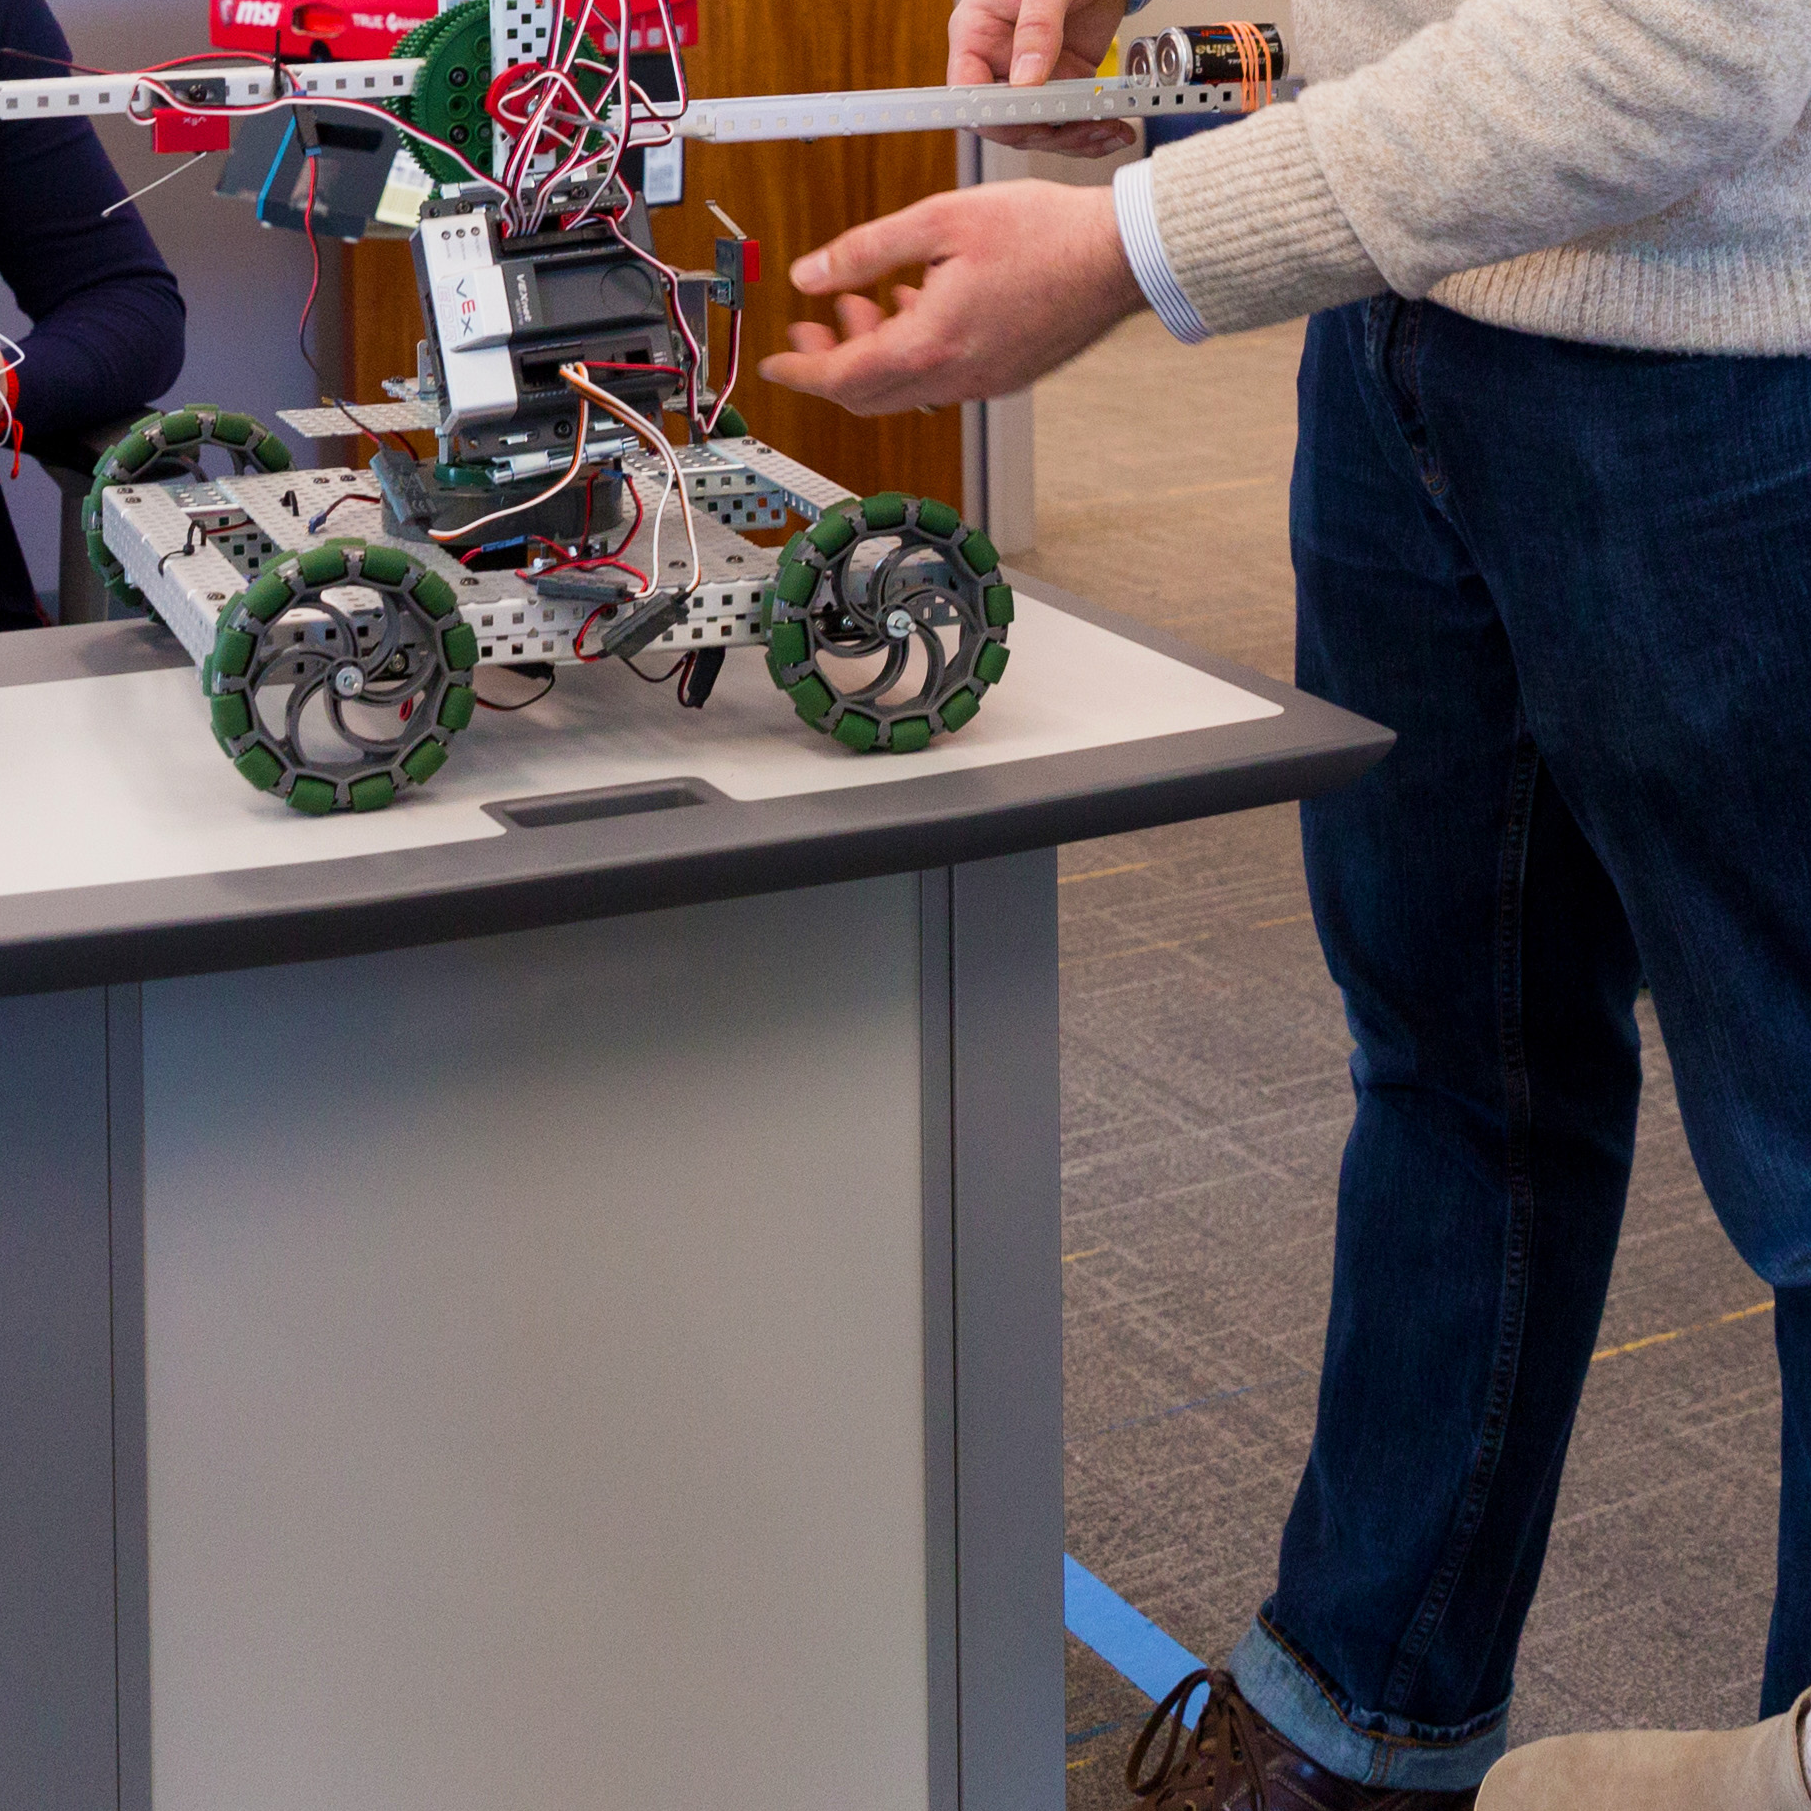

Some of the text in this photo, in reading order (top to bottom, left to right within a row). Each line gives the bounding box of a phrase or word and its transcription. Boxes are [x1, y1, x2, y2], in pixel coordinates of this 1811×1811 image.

[236, 0, 282, 28] msi
[456, 278, 476, 337] VEX
[516, 273, 532, 323] VEXnet
